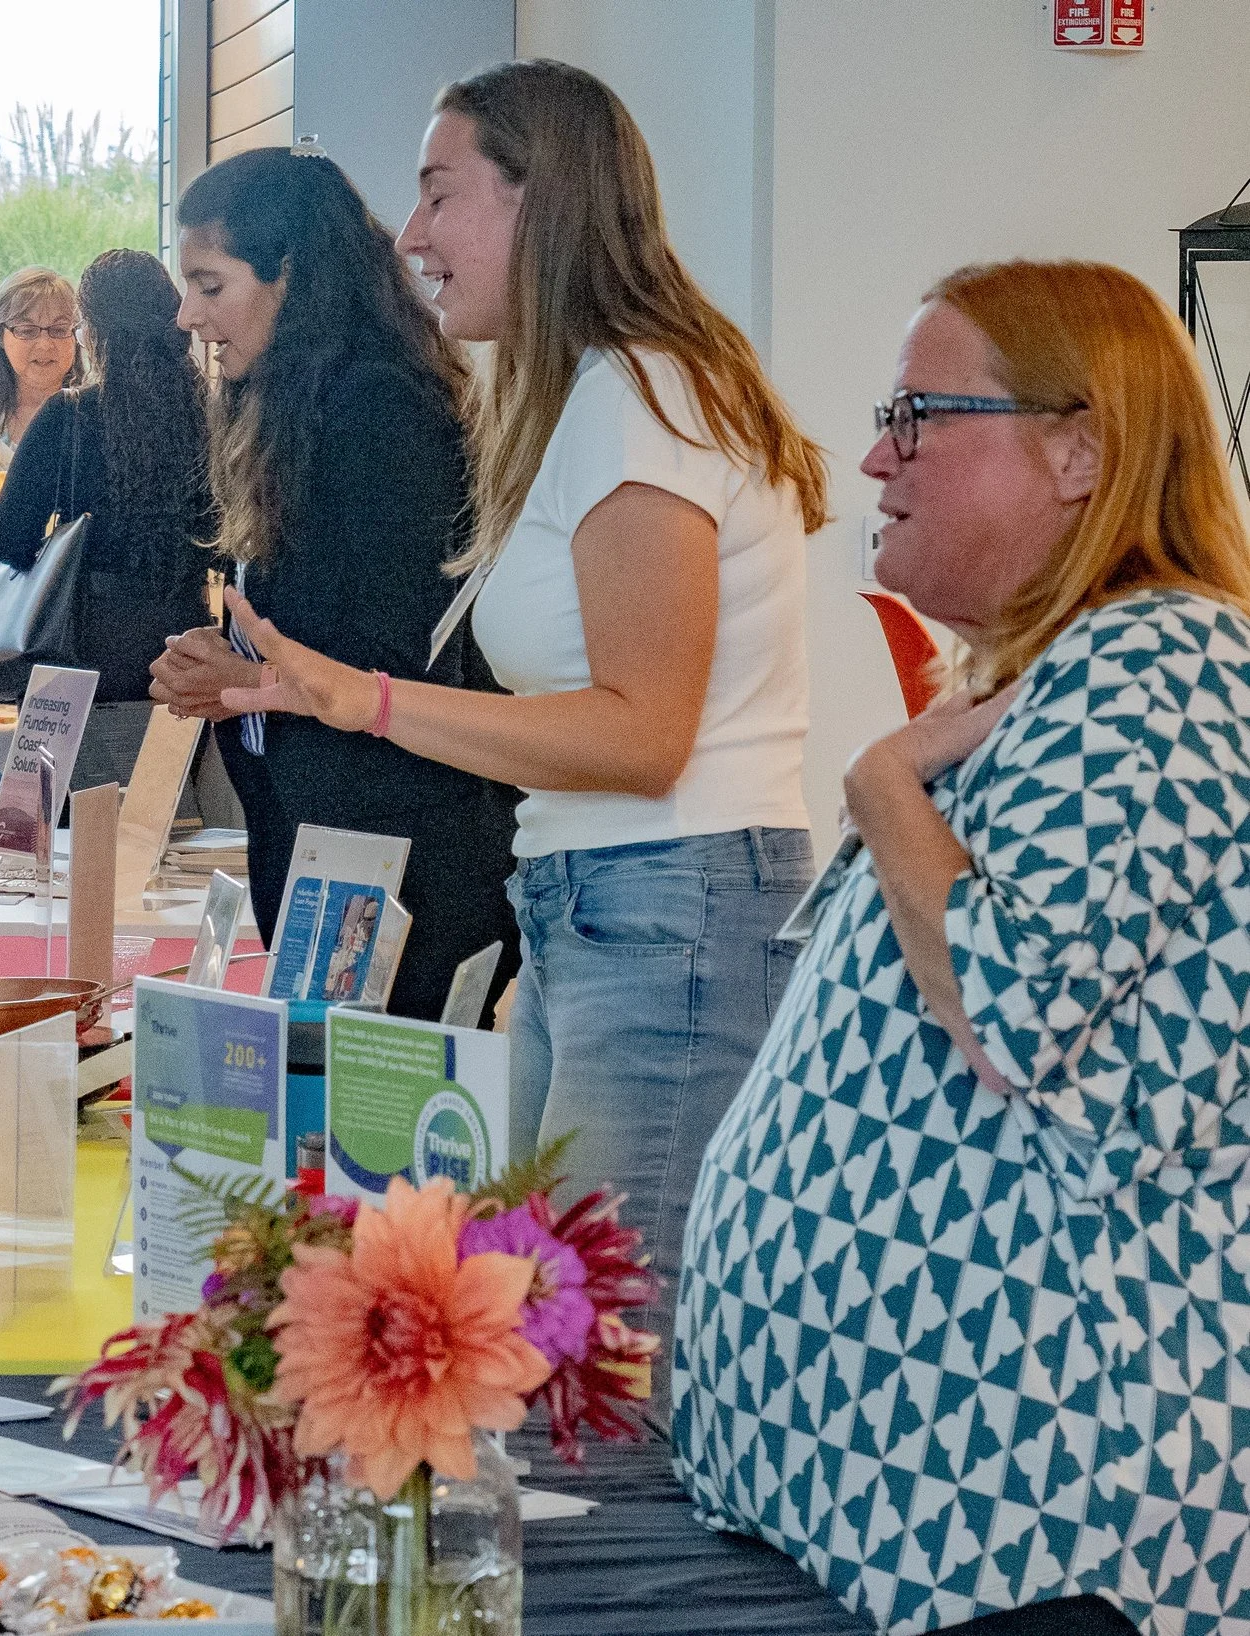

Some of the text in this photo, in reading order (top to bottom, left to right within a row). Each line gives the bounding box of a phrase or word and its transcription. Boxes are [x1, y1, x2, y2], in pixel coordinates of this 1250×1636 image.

[1058, 18, 1100, 26] EXTINGUISHER
[1069, 8, 1090, 17] FIRE
[1120, 8, 1135, 17] FIRE
[28, 694, 71, 716] Increasing
[23, 714, 72, 736] Funding for
[152, 1019, 179, 1037] Thrive
[224, 1041, 267, 1070] 200+
[427, 1131, 471, 1158] Thrive
[429, 1151, 470, 1184] RISE
